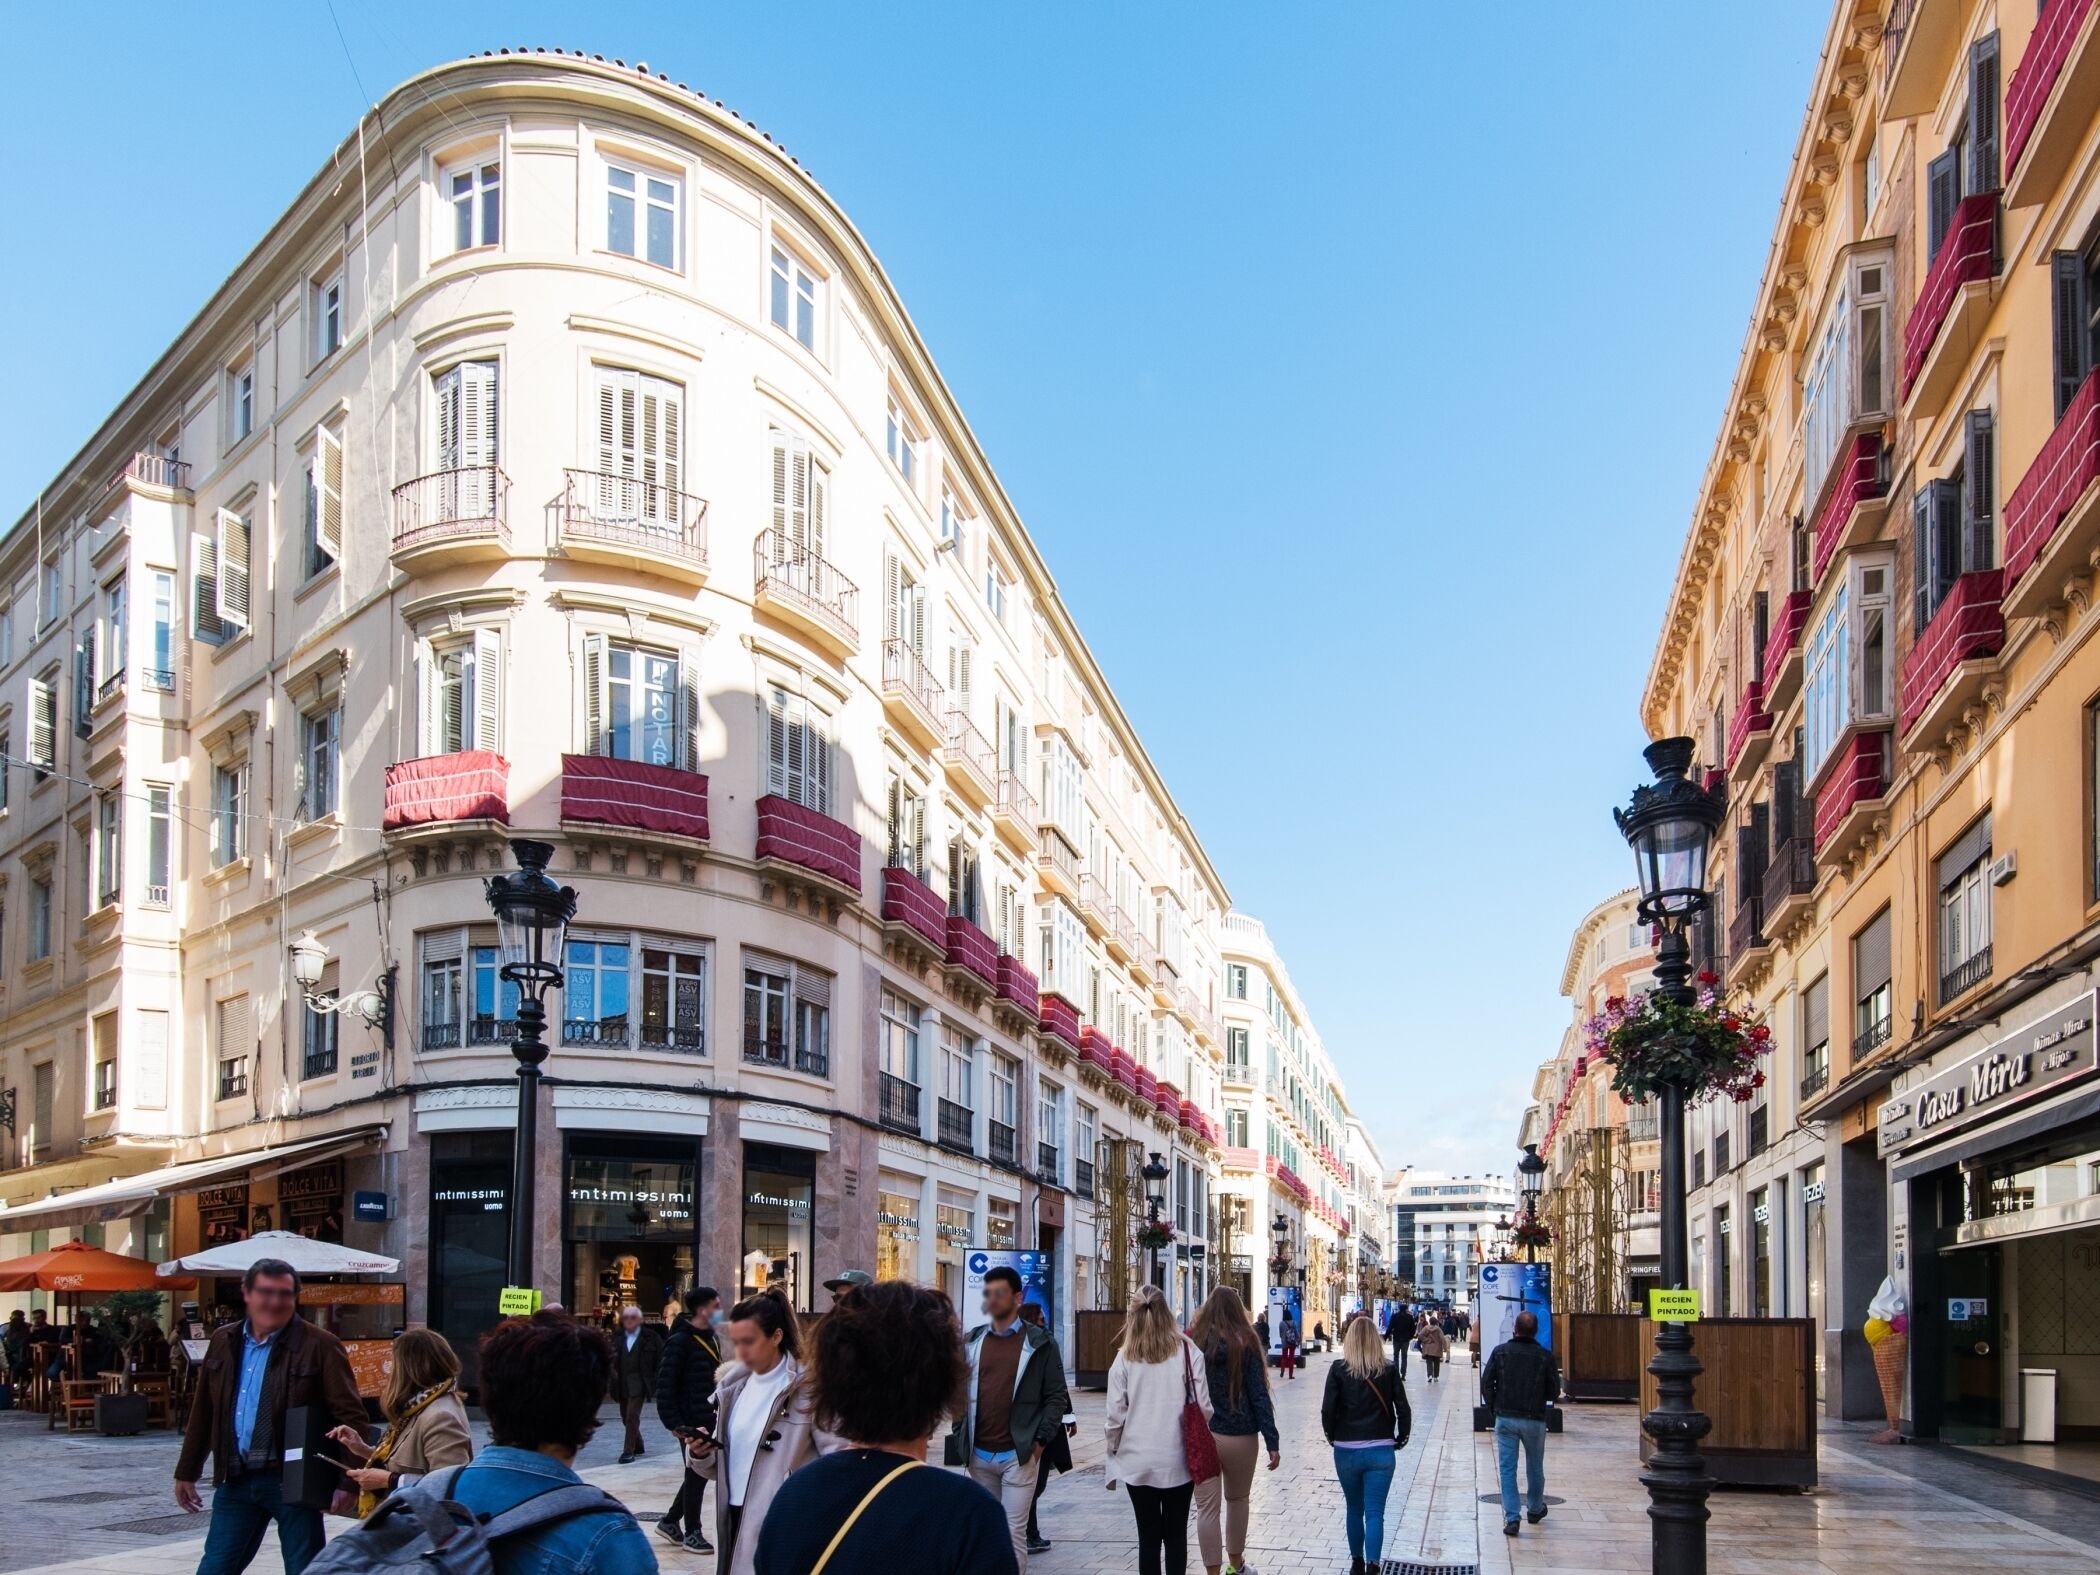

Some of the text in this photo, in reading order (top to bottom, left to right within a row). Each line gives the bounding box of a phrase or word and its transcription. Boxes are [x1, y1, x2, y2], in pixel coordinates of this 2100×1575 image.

[571, 976, 591, 984] ASV
[679, 985, 697, 994] ASV
[678, 1009, 697, 1018] ASV
[1916, 1053, 2028, 1129] Casa Mira
[283, 1175, 337, 1196] DOLCE VITA
[200, 1187, 243, 1206] DOLCE VITA
[435, 1189, 504, 1200] intimissimi
[570, 1187, 691, 1203] intimissimi
[750, 1193, 811, 1209] intimissimi
[660, 1210, 689, 1218] uomo
[1660, 1296, 1692, 1304] RECIEN
[1657, 1308, 1696, 1316] PINTADO
